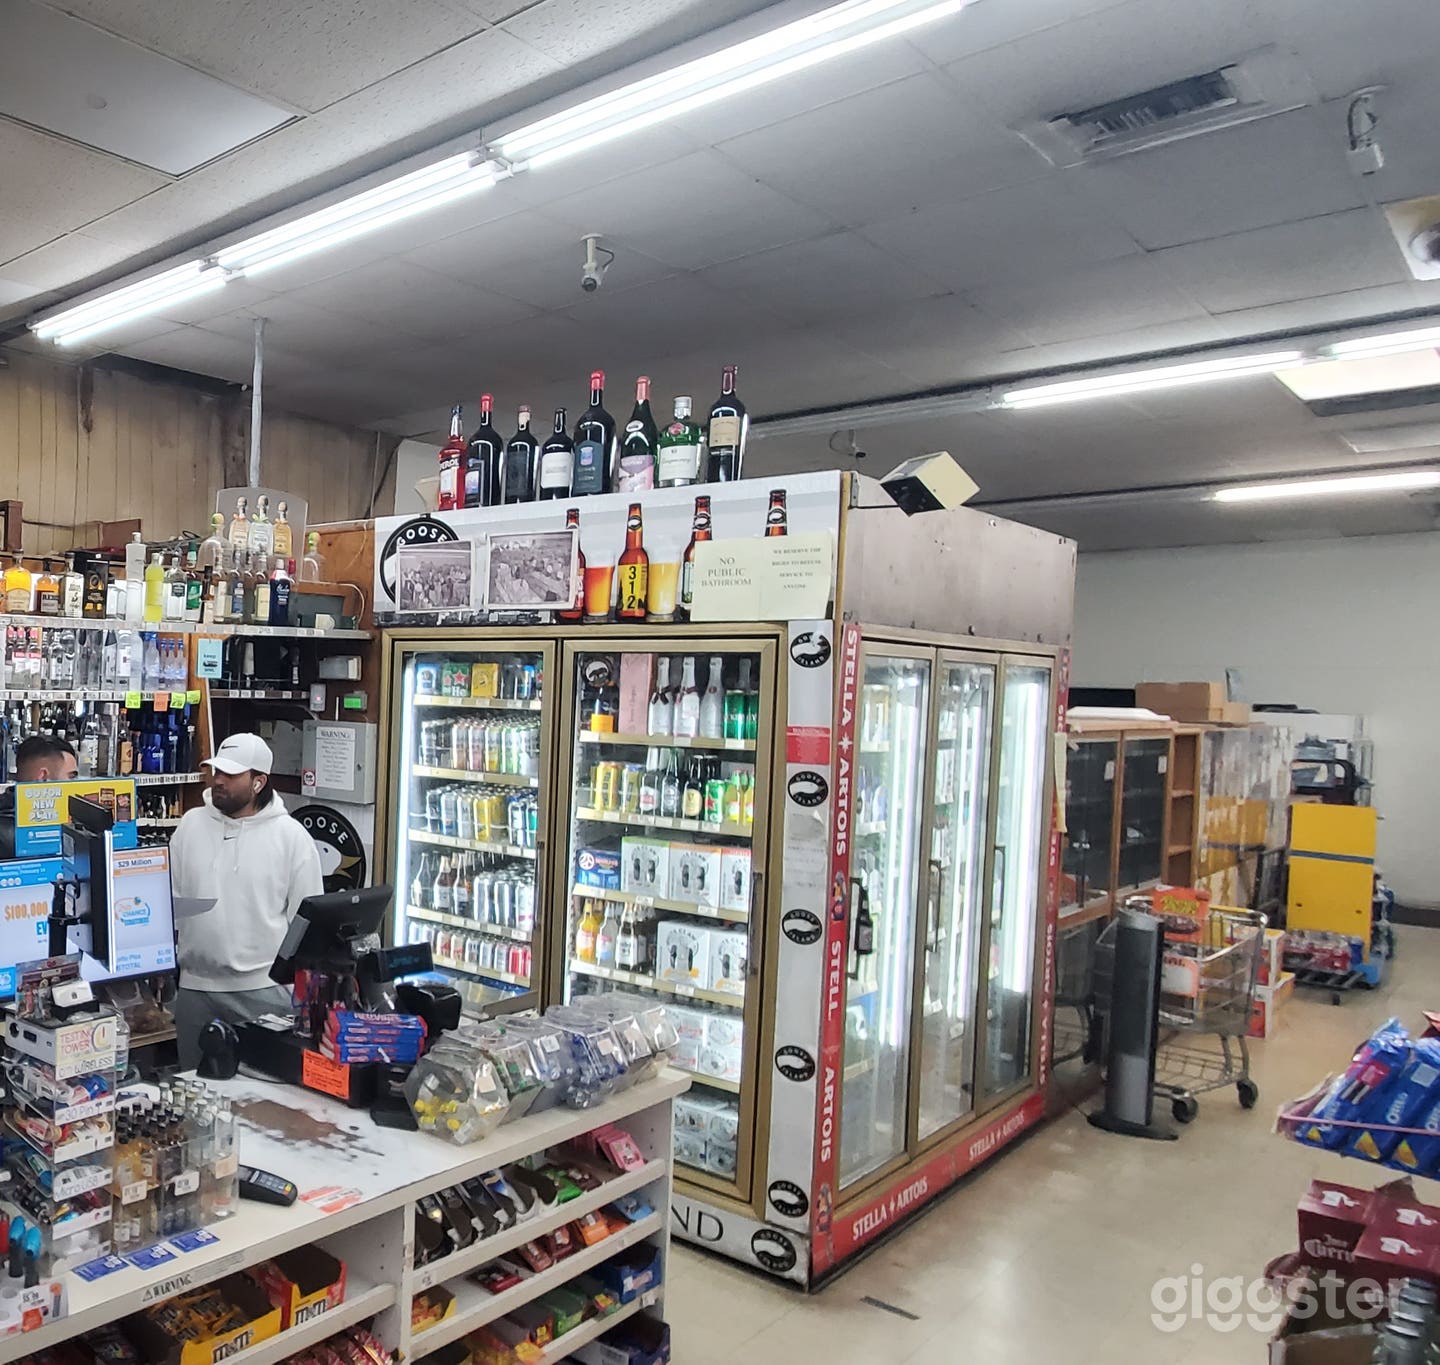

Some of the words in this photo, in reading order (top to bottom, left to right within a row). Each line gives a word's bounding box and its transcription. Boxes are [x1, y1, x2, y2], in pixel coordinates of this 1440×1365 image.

[396, 527, 448, 547] GOOSE
[707, 568, 746, 577] PUBLIC
[719, 557, 735, 566] NO
[701, 578, 752, 588] BATHROOM
[841, 631, 858, 727] STELLA
[32, 800, 56, 809] NEW
[836, 758, 850, 857] ARTOIS
[303, 816, 349, 845] OOSE
[821, 1066, 835, 1163] ARTOIS
[968, 1132, 996, 1160] STELLA
[852, 1209, 887, 1241] STELLA
[896, 1176, 928, 1212] ARTOIS
